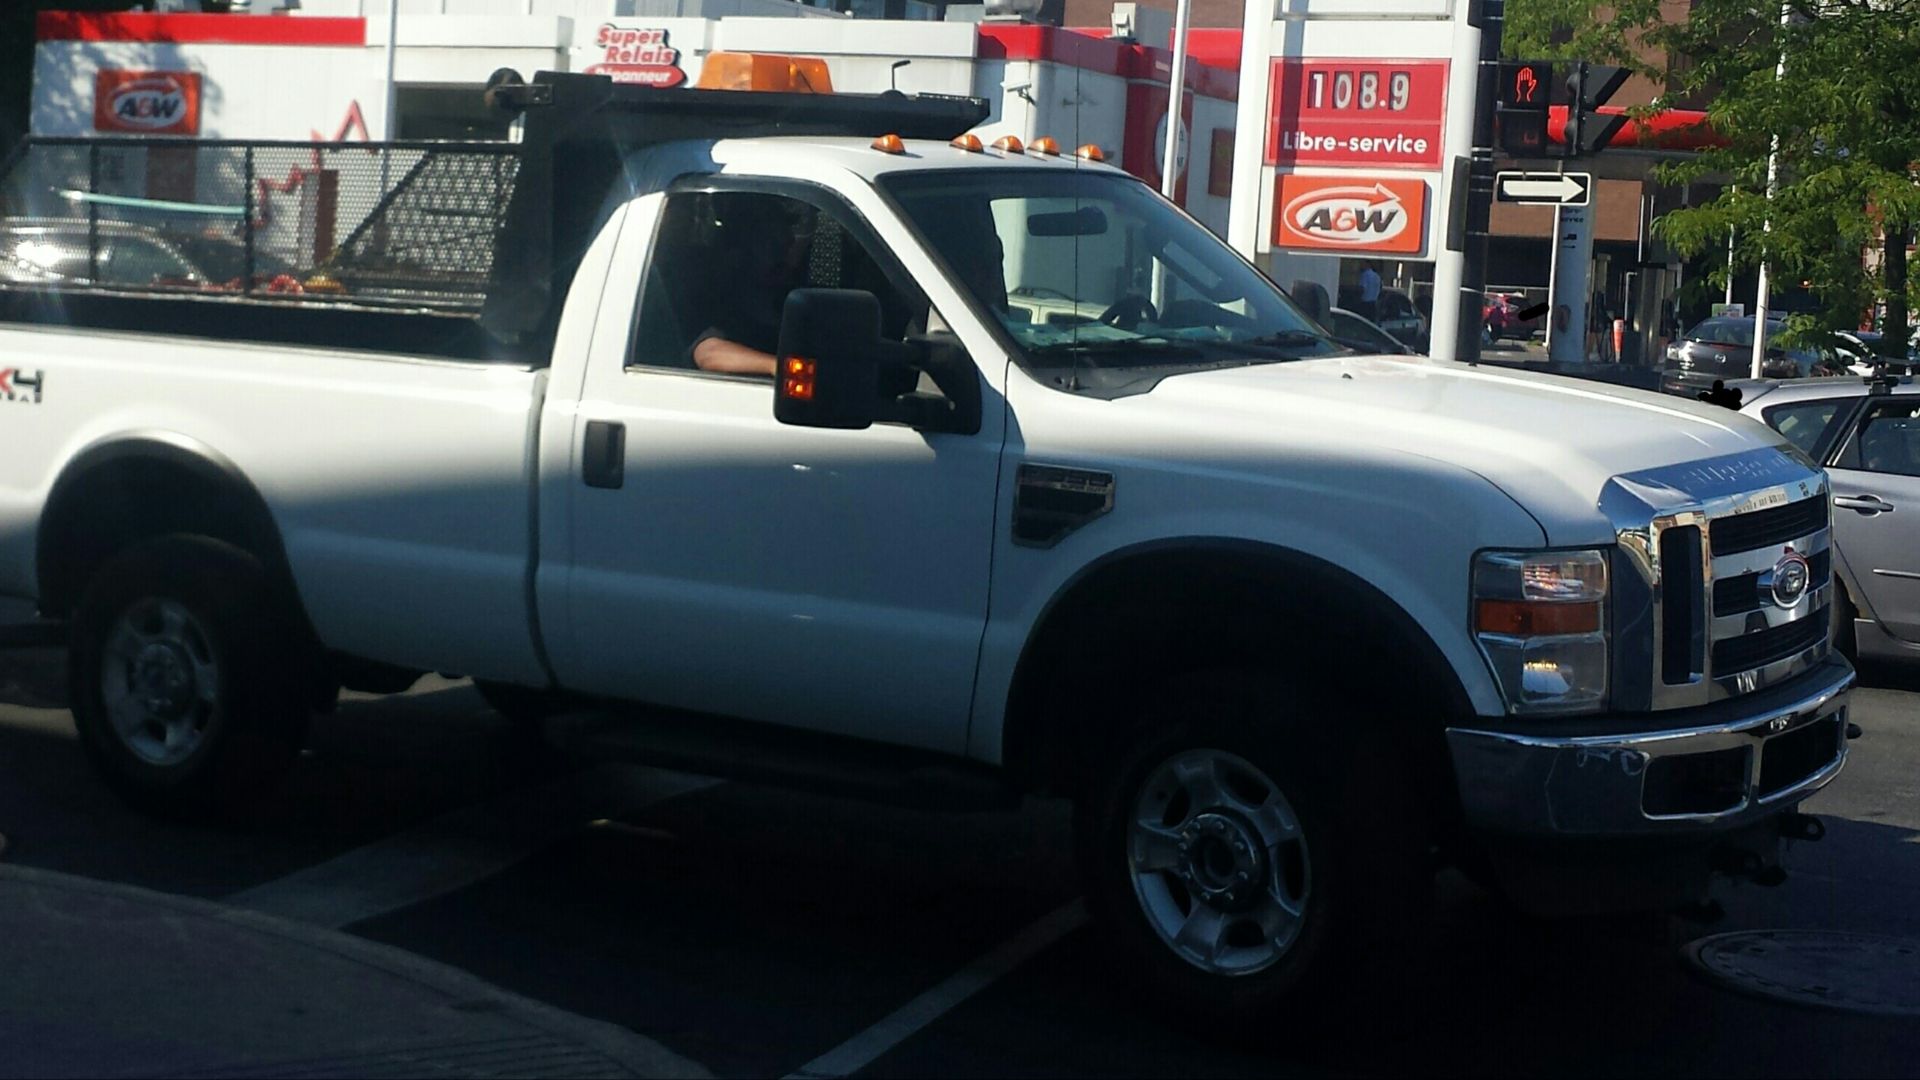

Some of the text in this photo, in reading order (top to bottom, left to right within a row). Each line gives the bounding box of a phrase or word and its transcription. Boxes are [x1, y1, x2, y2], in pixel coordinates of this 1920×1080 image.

[597, 26, 662, 47] Super
[605, 46, 674, 63] Relais
[595, 68, 671, 84] Dpanneur
[1313, 73, 1410, 111] 108.9
[119, 96, 180, 119] A&W
[1283, 131, 1428, 154] Libre-service
[1302, 206, 1399, 233] A&W
